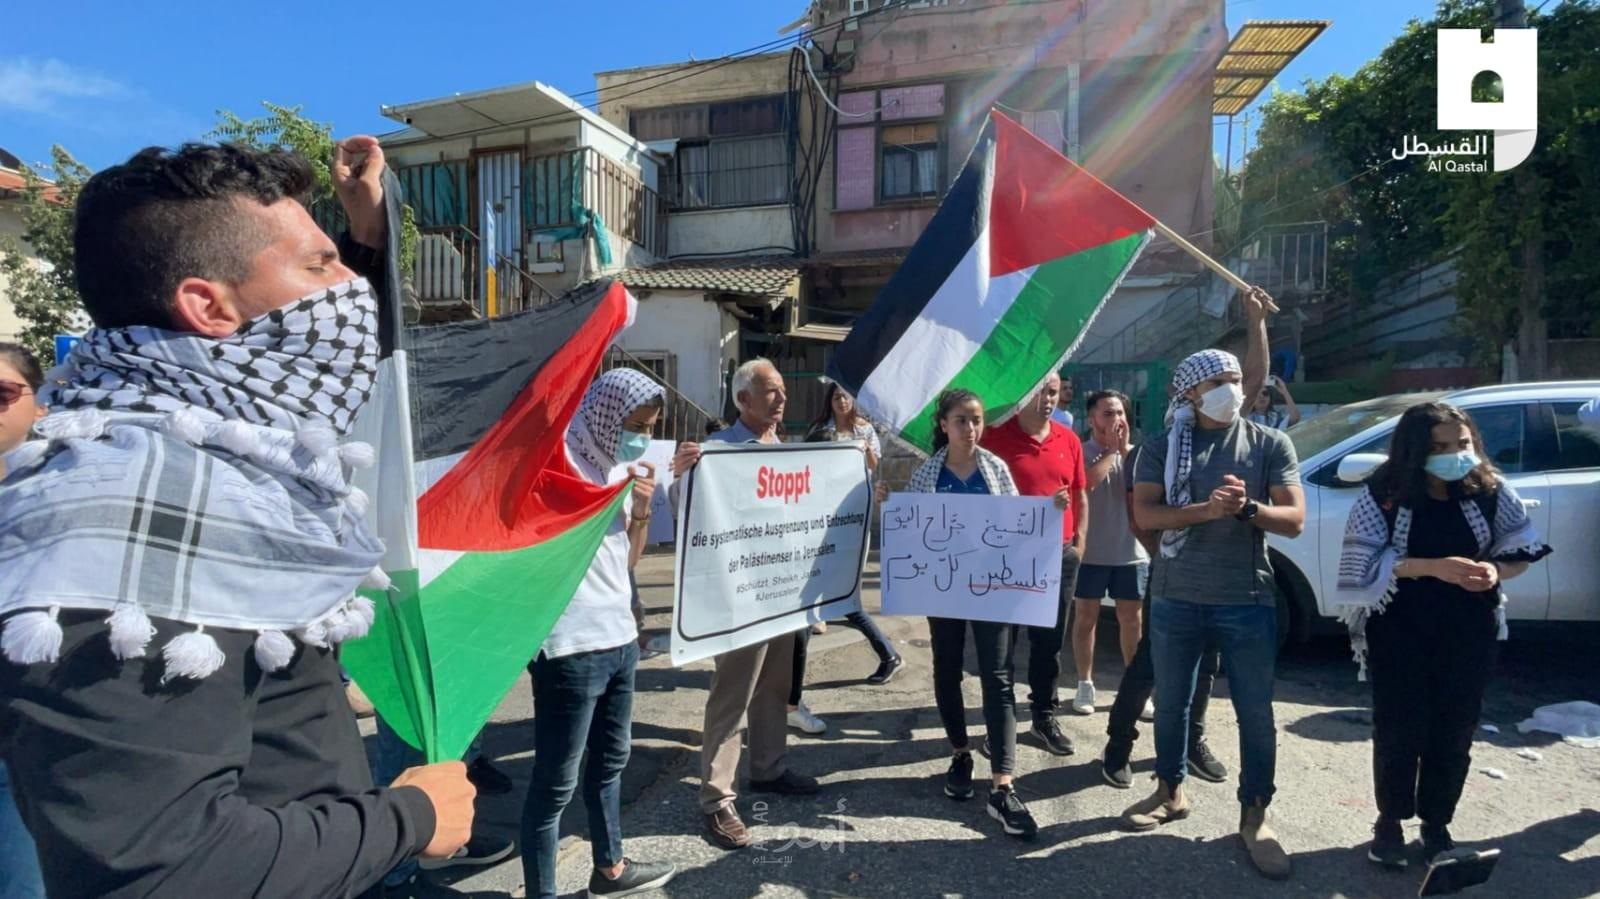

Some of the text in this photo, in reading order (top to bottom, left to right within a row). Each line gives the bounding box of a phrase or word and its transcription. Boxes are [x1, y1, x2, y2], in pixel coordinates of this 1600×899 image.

[757, 465, 811, 504] Stoppt
[692, 531, 708, 547] die
[710, 524, 763, 549] systematische
[765, 518, 809, 537] Ausgrenzung
[811, 514, 825, 530] und
[728, 543, 836, 573] der Palästinenser in Jerusalem
[969, 554, 1048, 596] فلسطين
[755, 586, 799, 602] #Jerusalem
